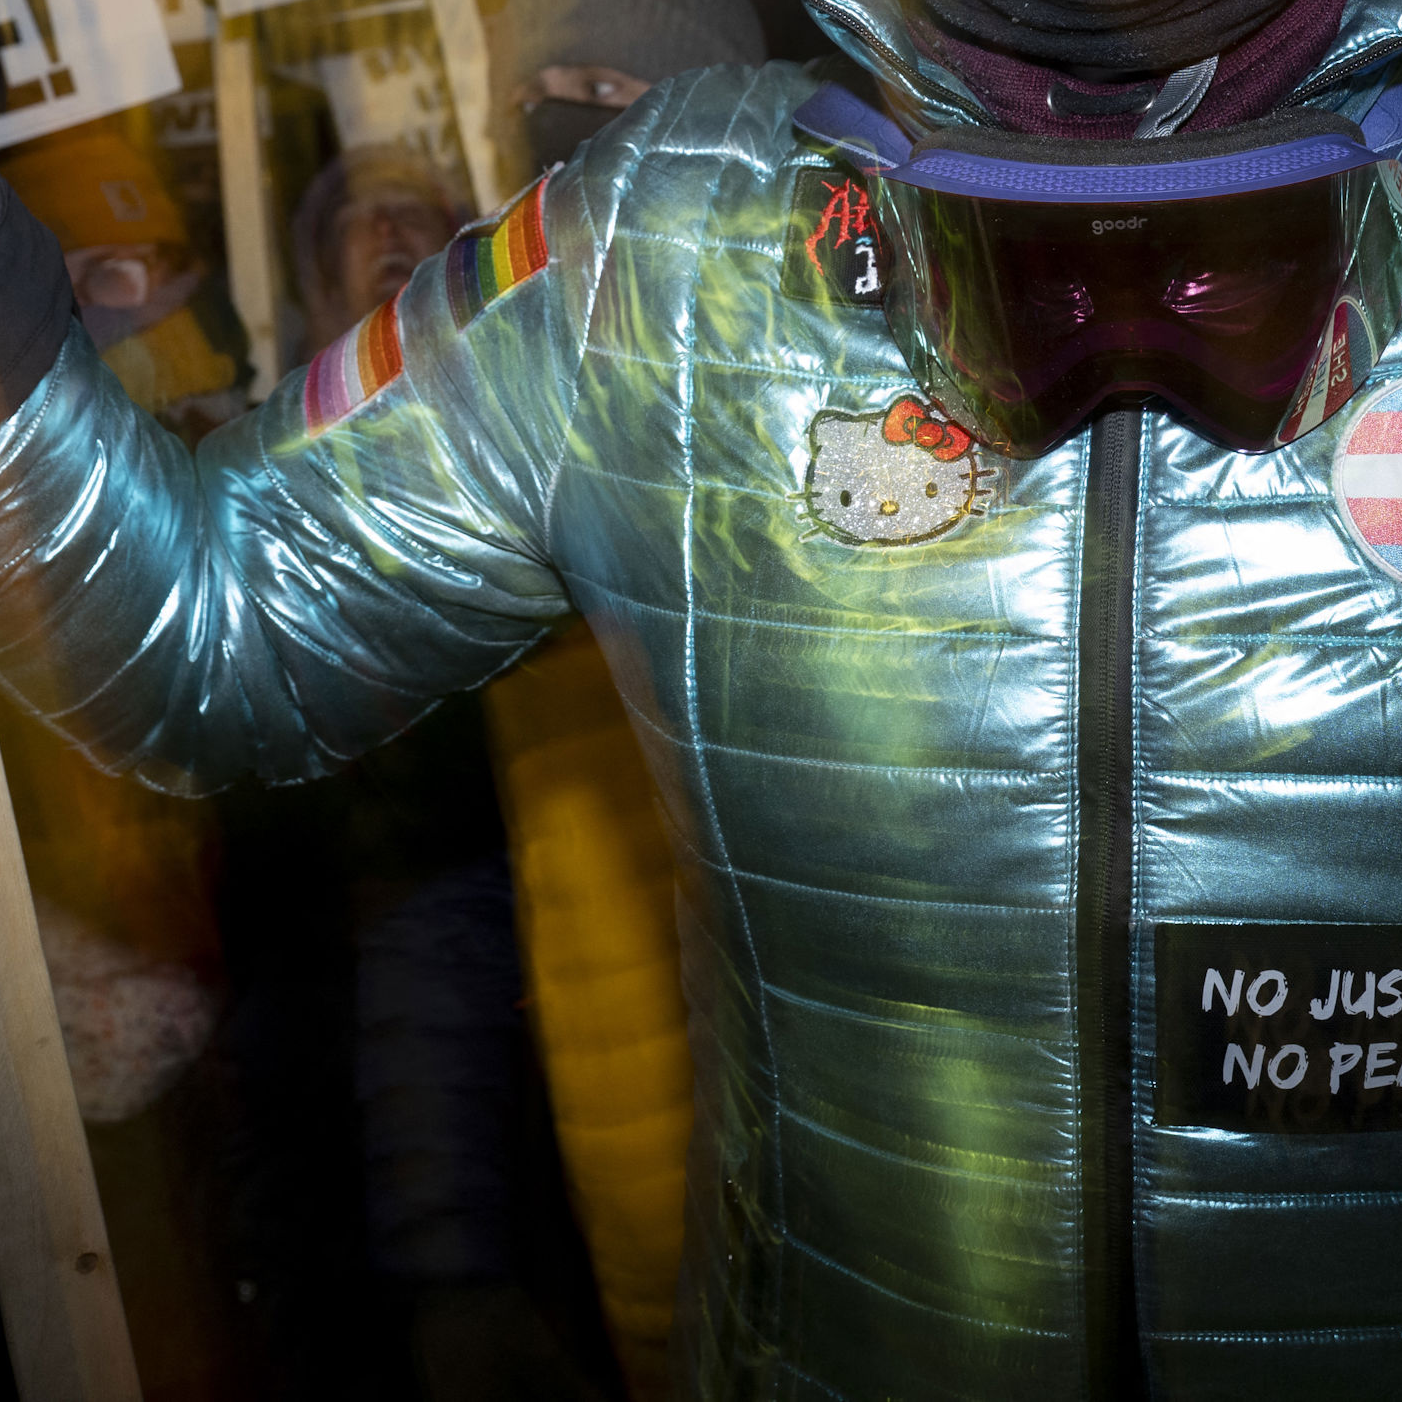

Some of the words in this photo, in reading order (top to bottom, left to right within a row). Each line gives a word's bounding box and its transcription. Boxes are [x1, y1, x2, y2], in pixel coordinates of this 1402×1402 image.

[1092, 216, 1148, 235] goodr
[1201, 967, 1290, 1018] NO
[1222, 1042, 1310, 1092] NO
